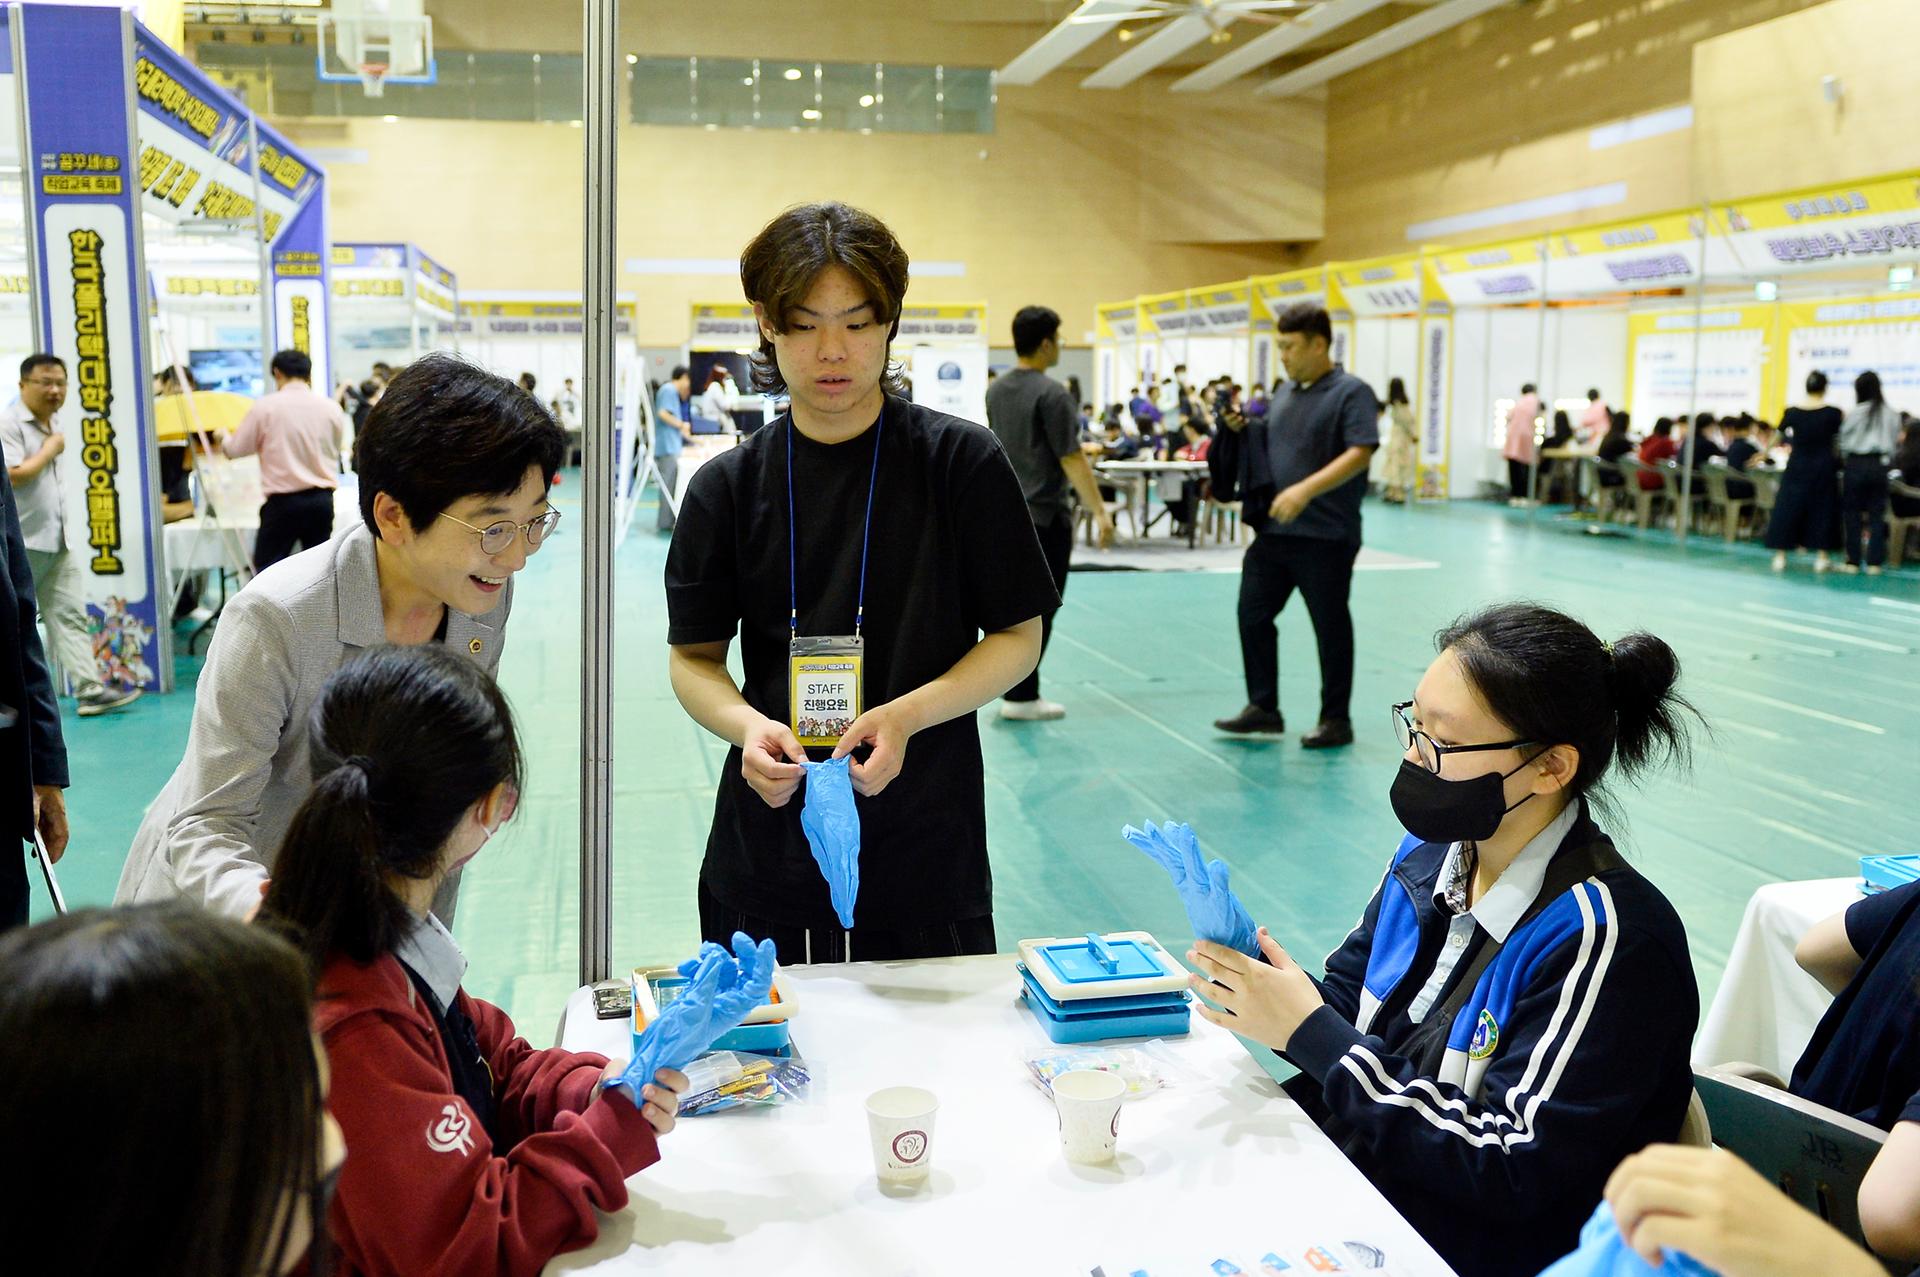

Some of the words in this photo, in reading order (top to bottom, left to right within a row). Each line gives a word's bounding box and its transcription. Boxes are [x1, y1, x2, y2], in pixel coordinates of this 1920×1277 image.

[69, 229, 112, 418] 한국폴리텍대학
[82, 418, 124, 575] 바이오캠퍼스
[804, 699, 848, 711] 진행요원
[808, 684, 844, 694] STAFF
